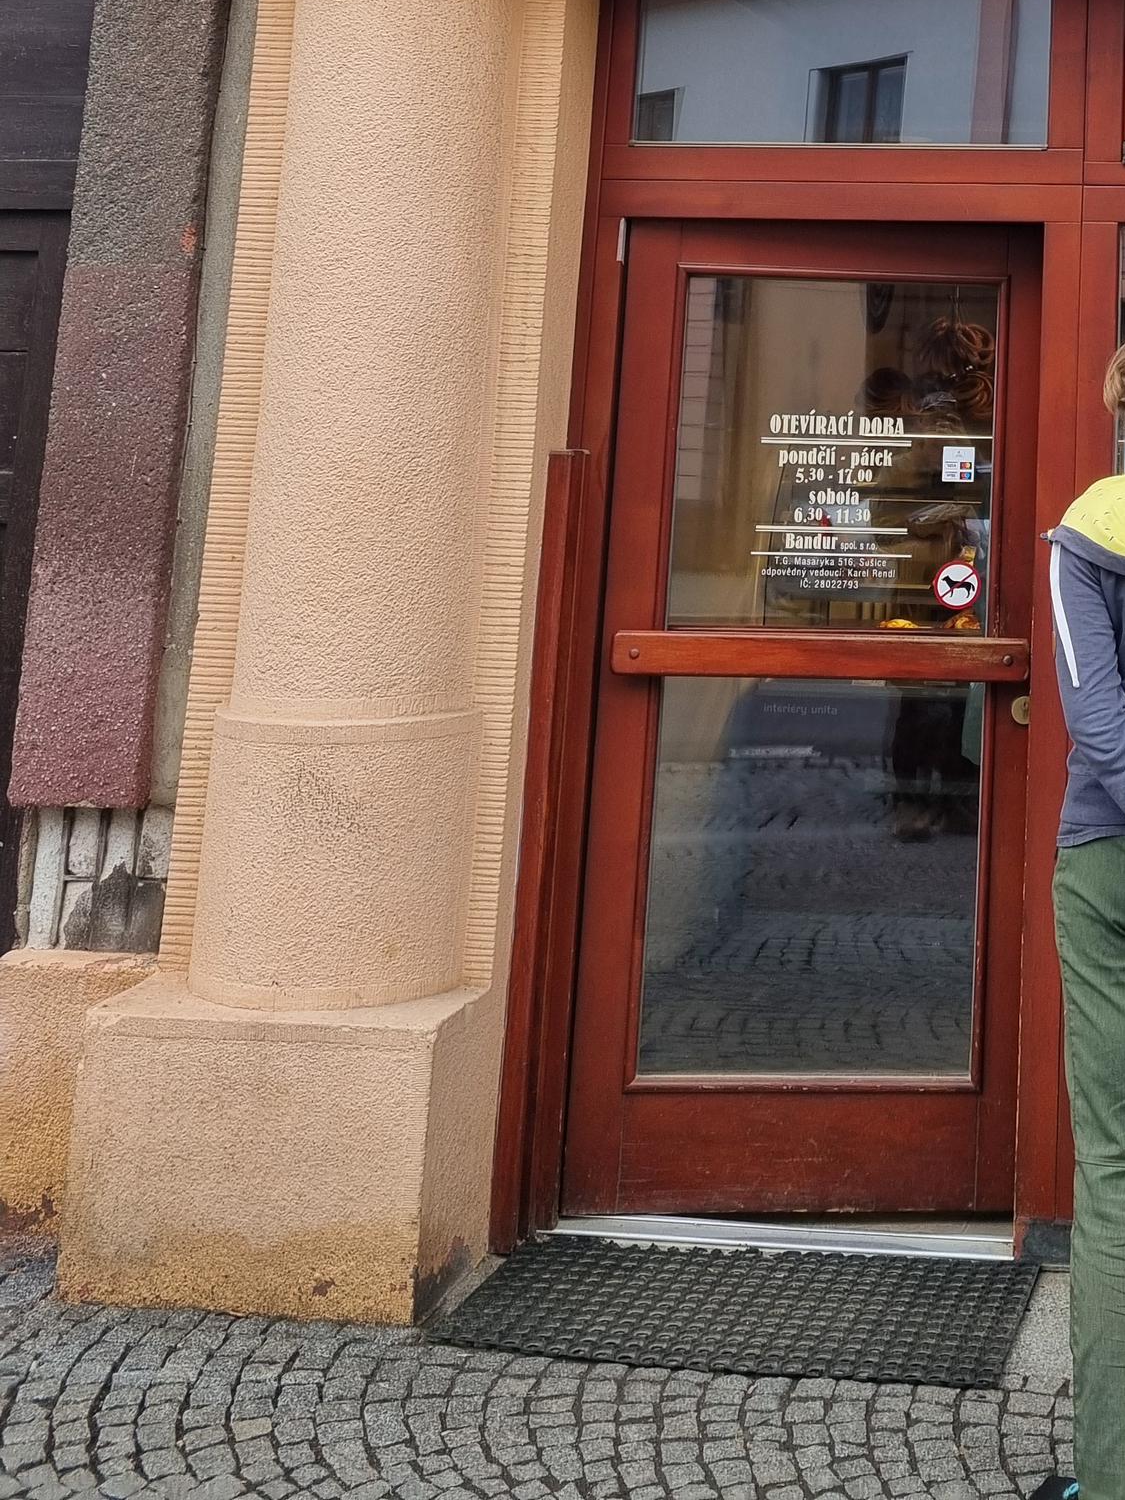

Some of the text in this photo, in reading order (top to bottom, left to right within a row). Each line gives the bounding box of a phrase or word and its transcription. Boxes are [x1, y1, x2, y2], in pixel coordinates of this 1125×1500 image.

[769, 409, 905, 437] OTEVÍRACÍ DOBA
[778, 445, 837, 468] pondělí
[850, 447, 893, 469] pátek
[795, 467, 825, 484] 5.30
[837, 468, 873, 485] 17.00
[808, 487, 860, 506] sobota
[793, 507, 823, 524] 6.30
[835, 508, 871, 525] 11.30
[784, 532, 839, 550] Bandur
[840, 541, 858, 552] spol.
[866, 542, 879, 551] r.o.
[794, 557, 835, 568] Masaryka
[761, 566, 896, 579] odpovědný vedoucí: Karel Rendl
[799, 577, 860, 590] IČ: 28022793
